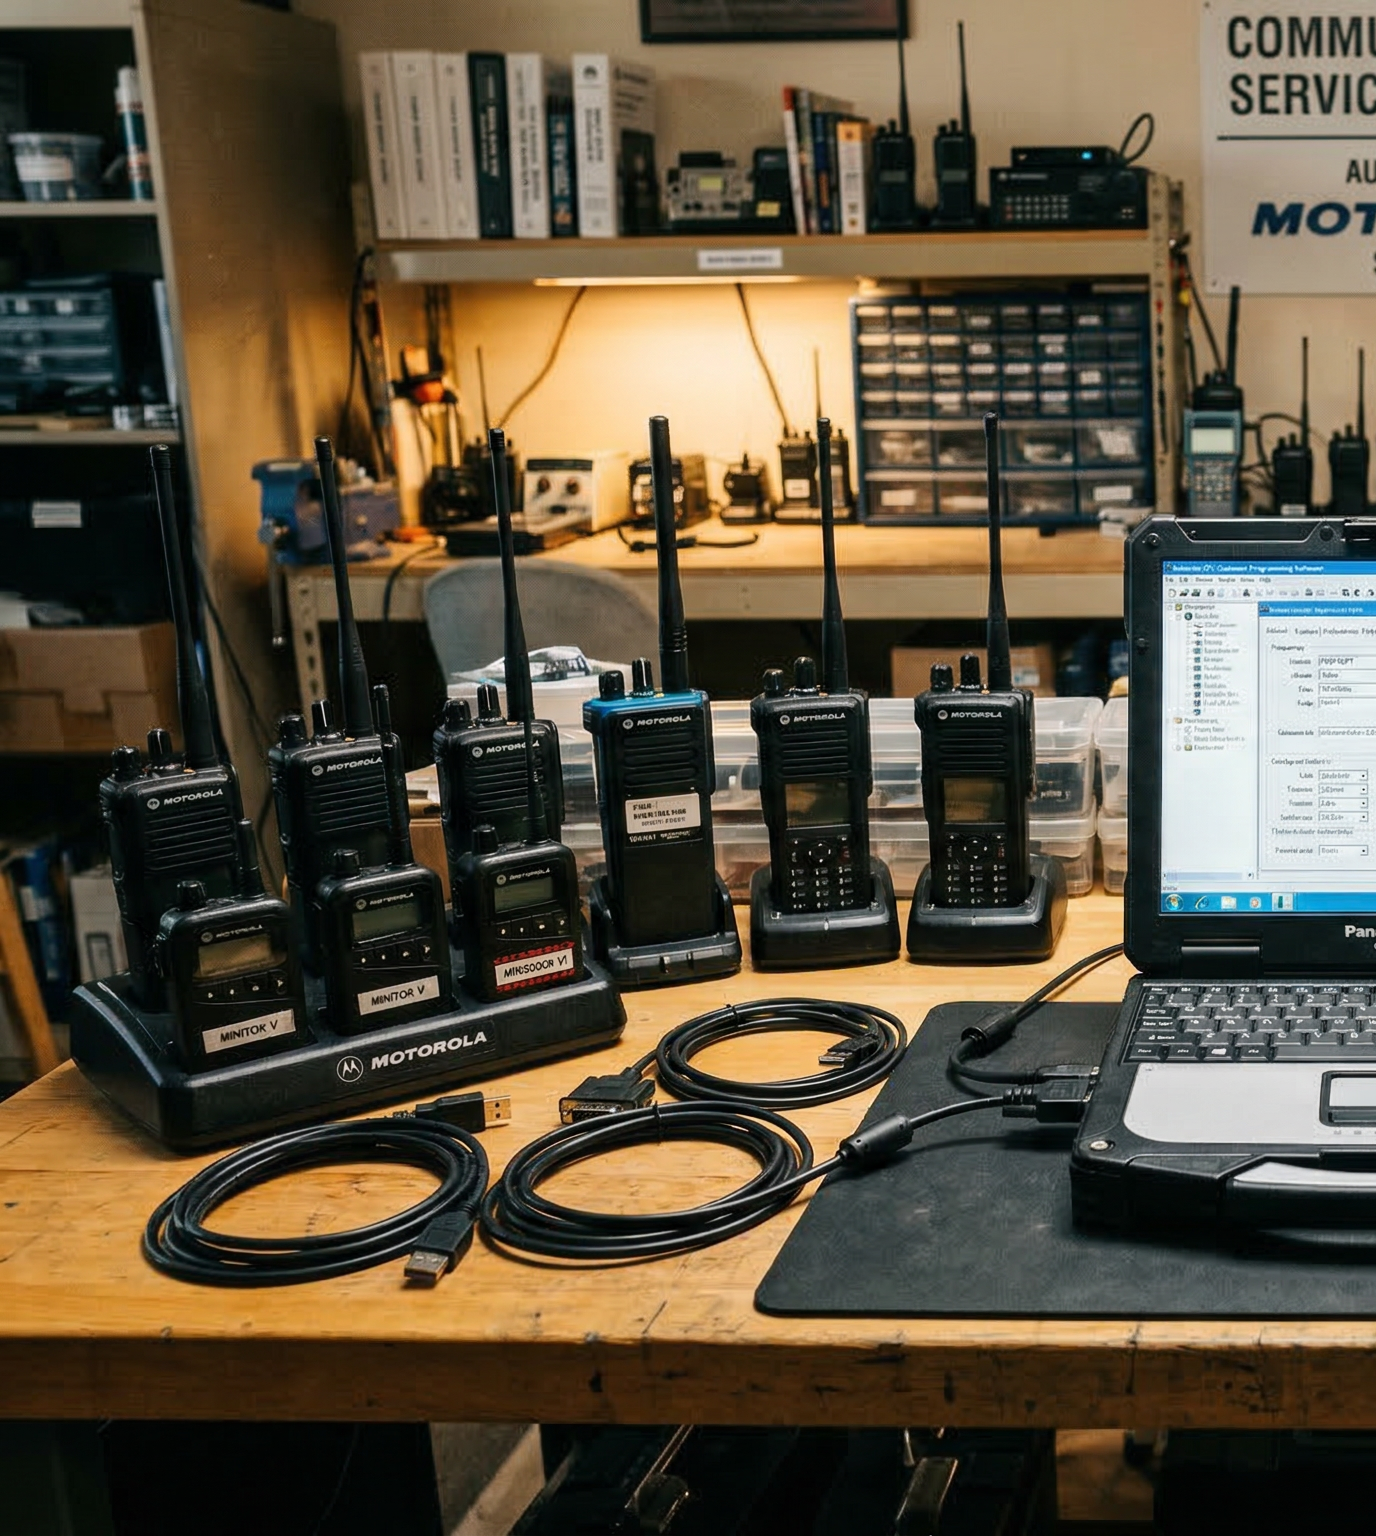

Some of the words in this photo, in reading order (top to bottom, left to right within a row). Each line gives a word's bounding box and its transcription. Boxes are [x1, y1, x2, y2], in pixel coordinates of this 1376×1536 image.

[326, 756, 383, 773] MOTOROLA
[163, 788, 224, 806] MOTOROLA
[417, 985, 425, 995] V
[270, 1020, 278, 1030] V
[371, 1031, 488, 1070] MOTOROLA
